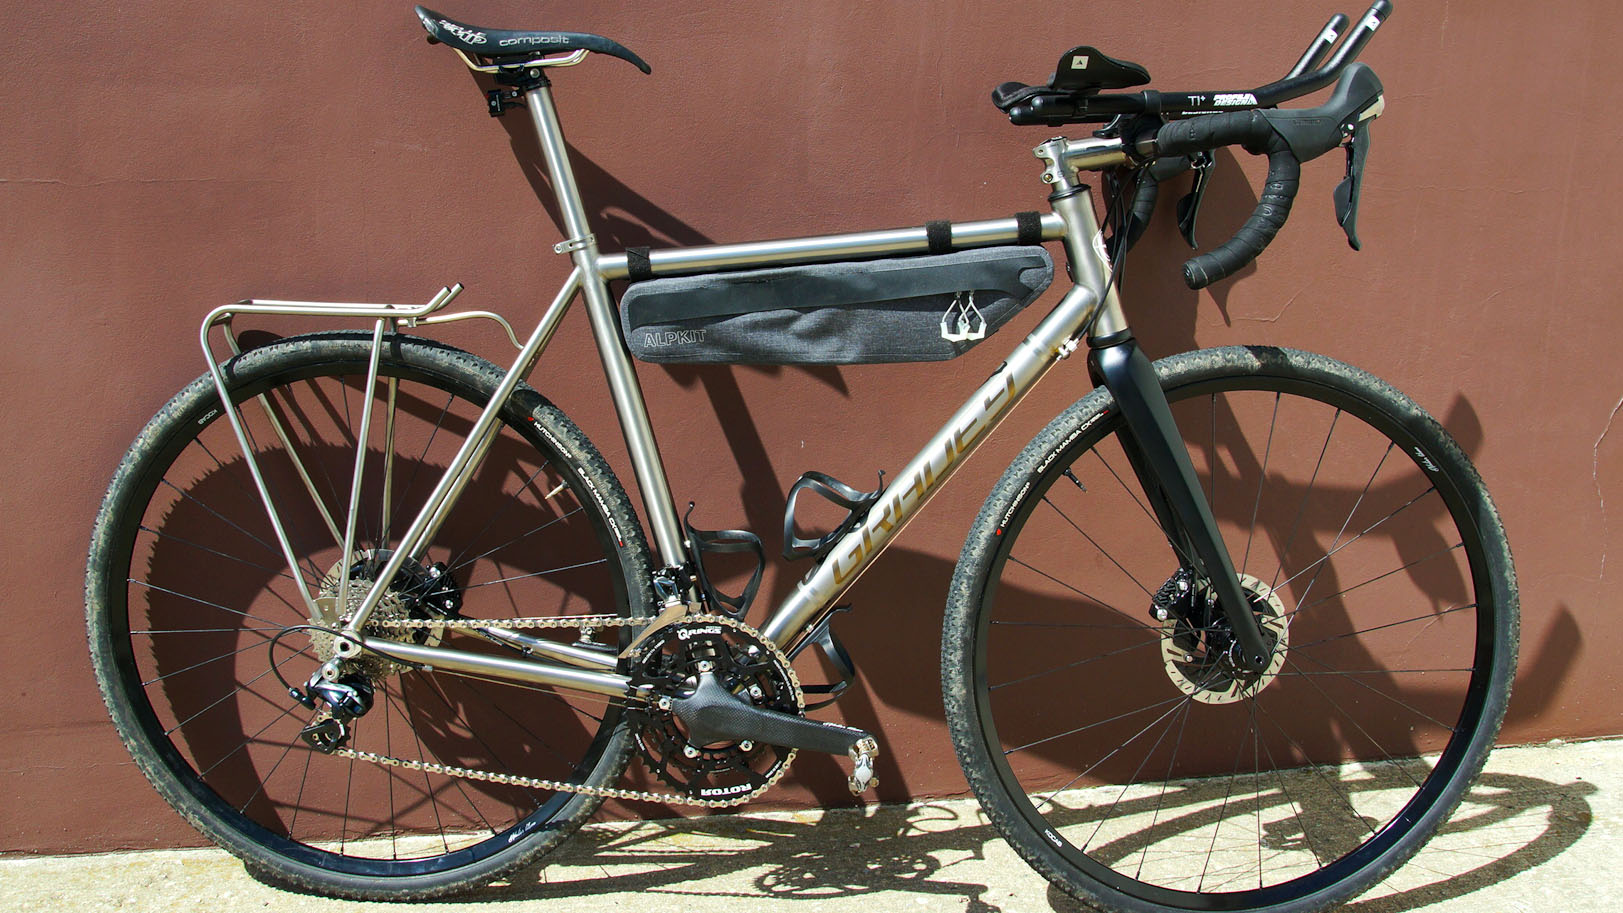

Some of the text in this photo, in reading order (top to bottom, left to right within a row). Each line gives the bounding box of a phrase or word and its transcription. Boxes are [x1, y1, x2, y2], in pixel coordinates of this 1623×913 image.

[499, 34, 570, 46] composit
[644, 329, 706, 348] ALPKIT
[1037, 451, 1057, 474] BLACK
[1055, 430, 1082, 453] MAMBA
[577, 467, 595, 490] BLACK
[593, 488, 611, 517] MAMBA
[701, 783, 752, 796] ROTOR
